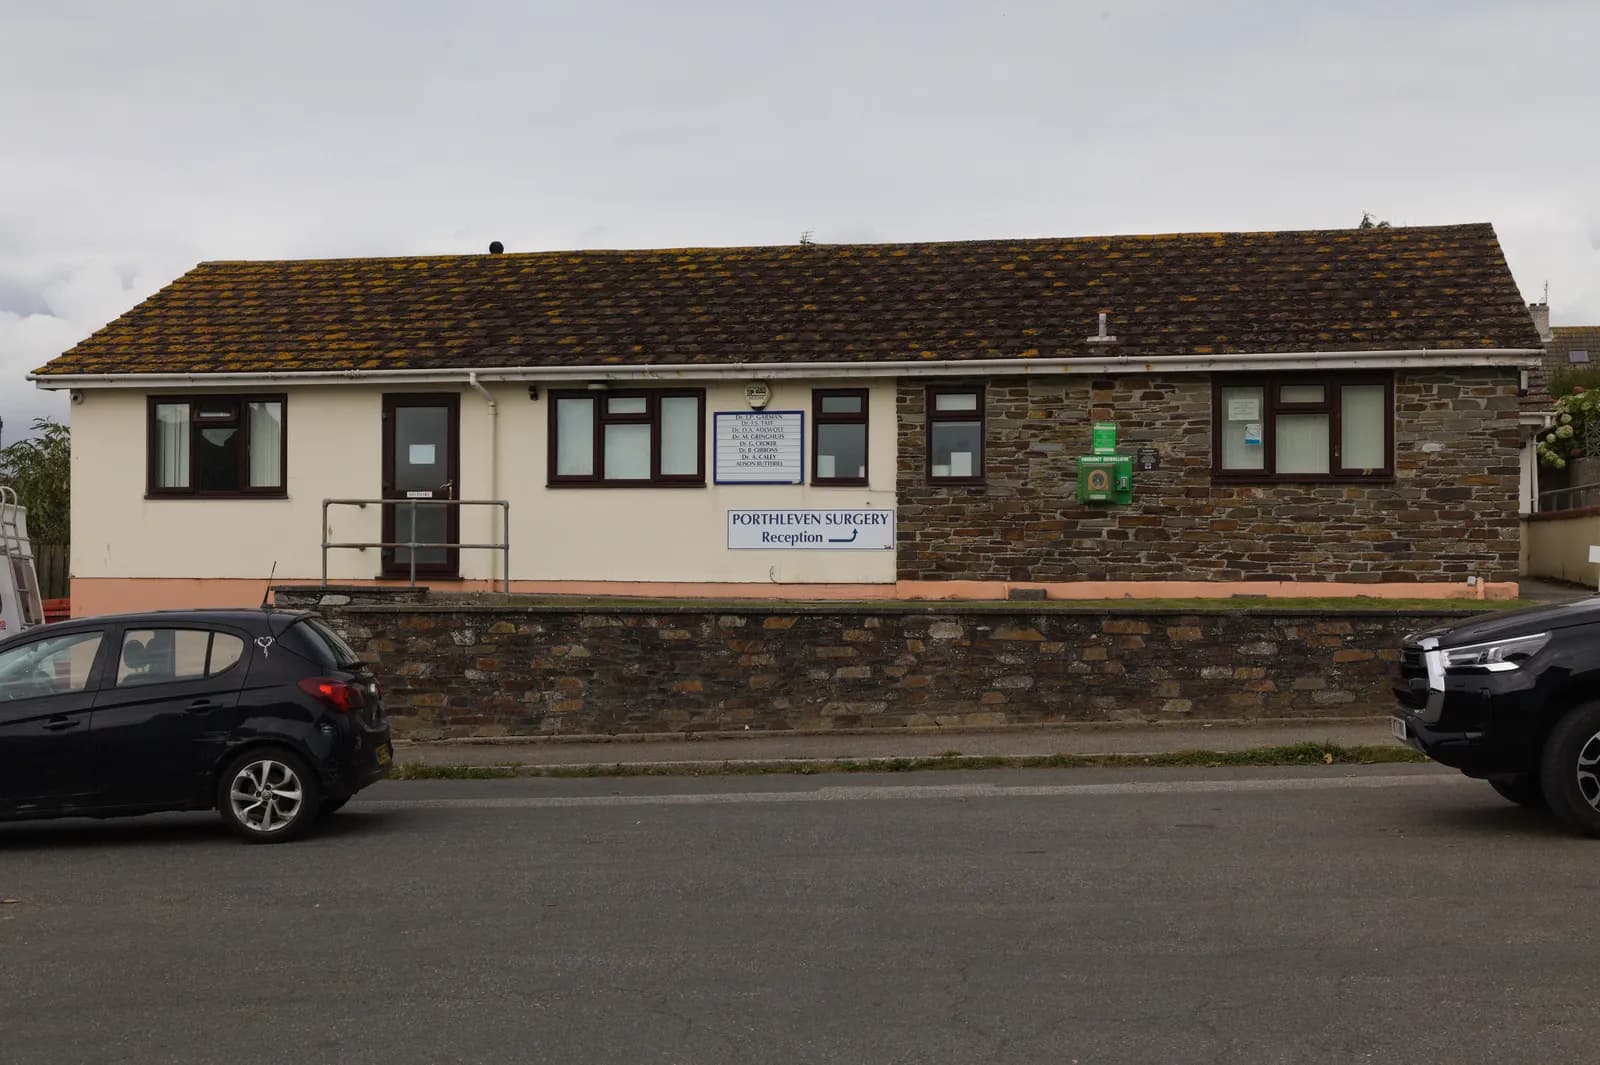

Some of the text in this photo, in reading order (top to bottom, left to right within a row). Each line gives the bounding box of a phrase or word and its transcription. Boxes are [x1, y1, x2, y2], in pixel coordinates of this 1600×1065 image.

[732, 513, 889, 525] PORTHLEVEN SURGERY
[762, 531, 823, 546] Reception
